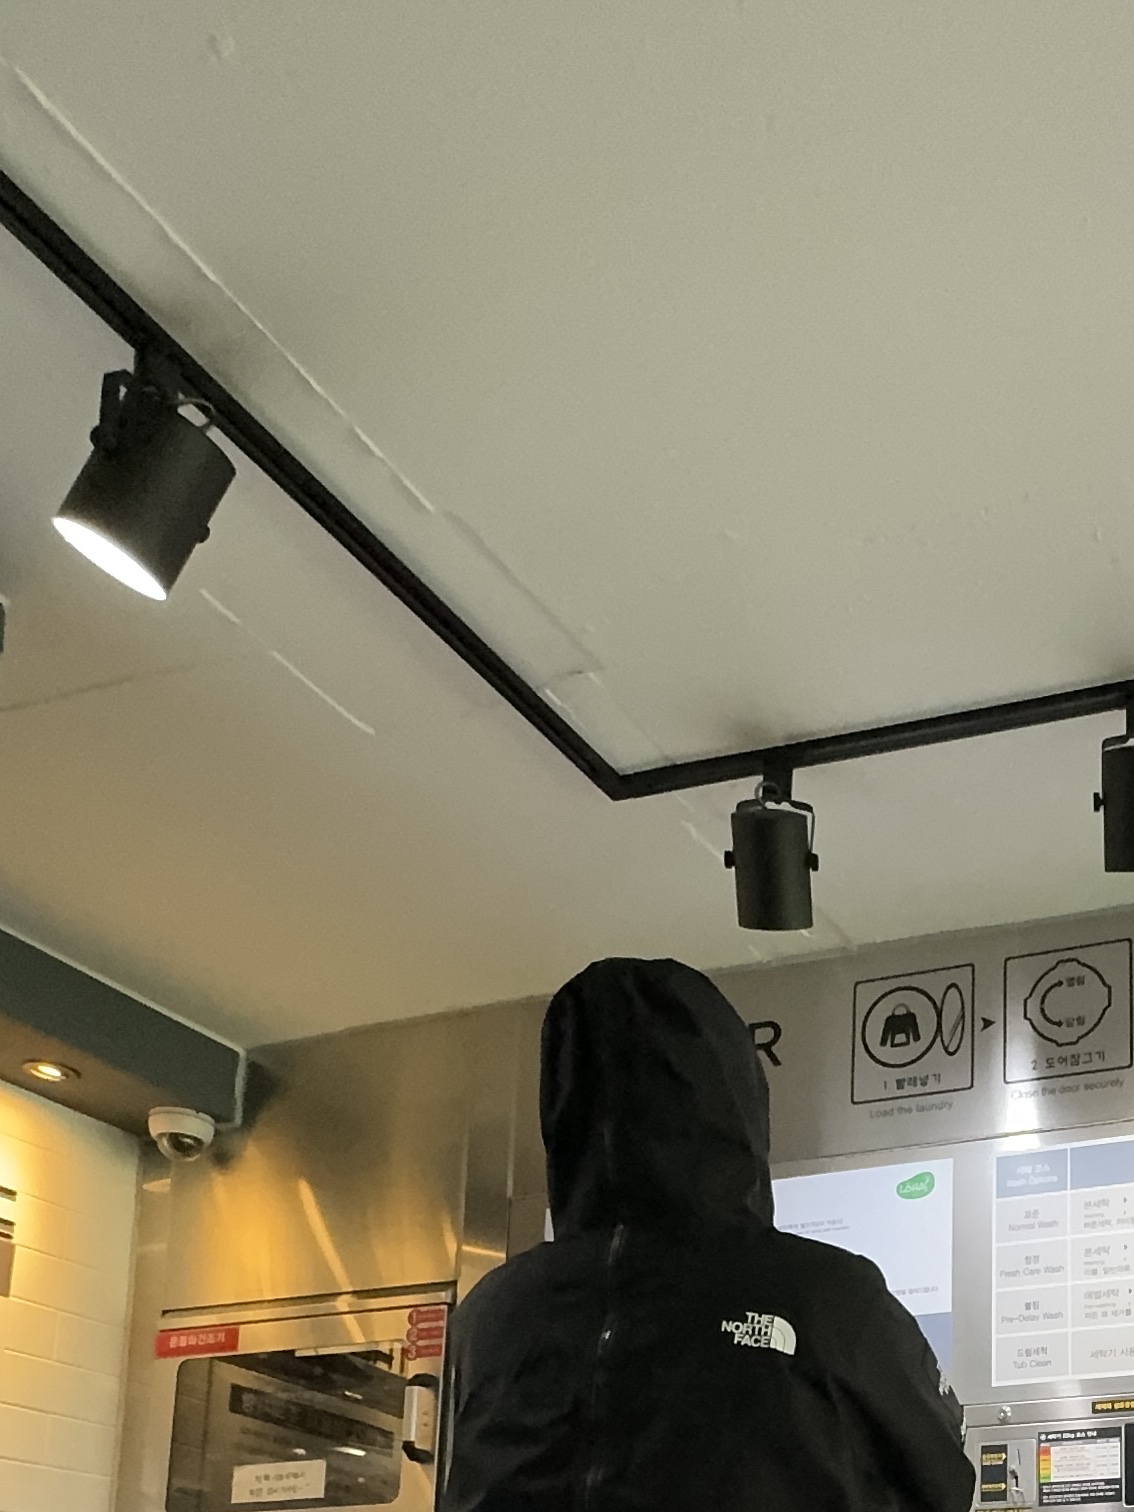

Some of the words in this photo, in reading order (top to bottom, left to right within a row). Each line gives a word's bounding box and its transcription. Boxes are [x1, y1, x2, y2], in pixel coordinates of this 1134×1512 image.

[1045, 1051, 1106, 1069] 도어잠그기
[895, 1073, 941, 1091] 빨래넣기
[1010, 1088, 1039, 1100] Close
[1041, 1086, 1057, 1097] the
[1059, 1083, 1081, 1094] door
[1084, 1077, 1124, 1092] securely
[870, 1107, 895, 1119] Load
[898, 1105, 913, 1115] the
[916, 1101, 953, 1114] laundry
[746, 1312, 774, 1326] THE
[721, 1320, 771, 1336] NORTH
[734, 1333, 770, 1348] FACE
[1013, 1360, 1027, 1369] Tub
